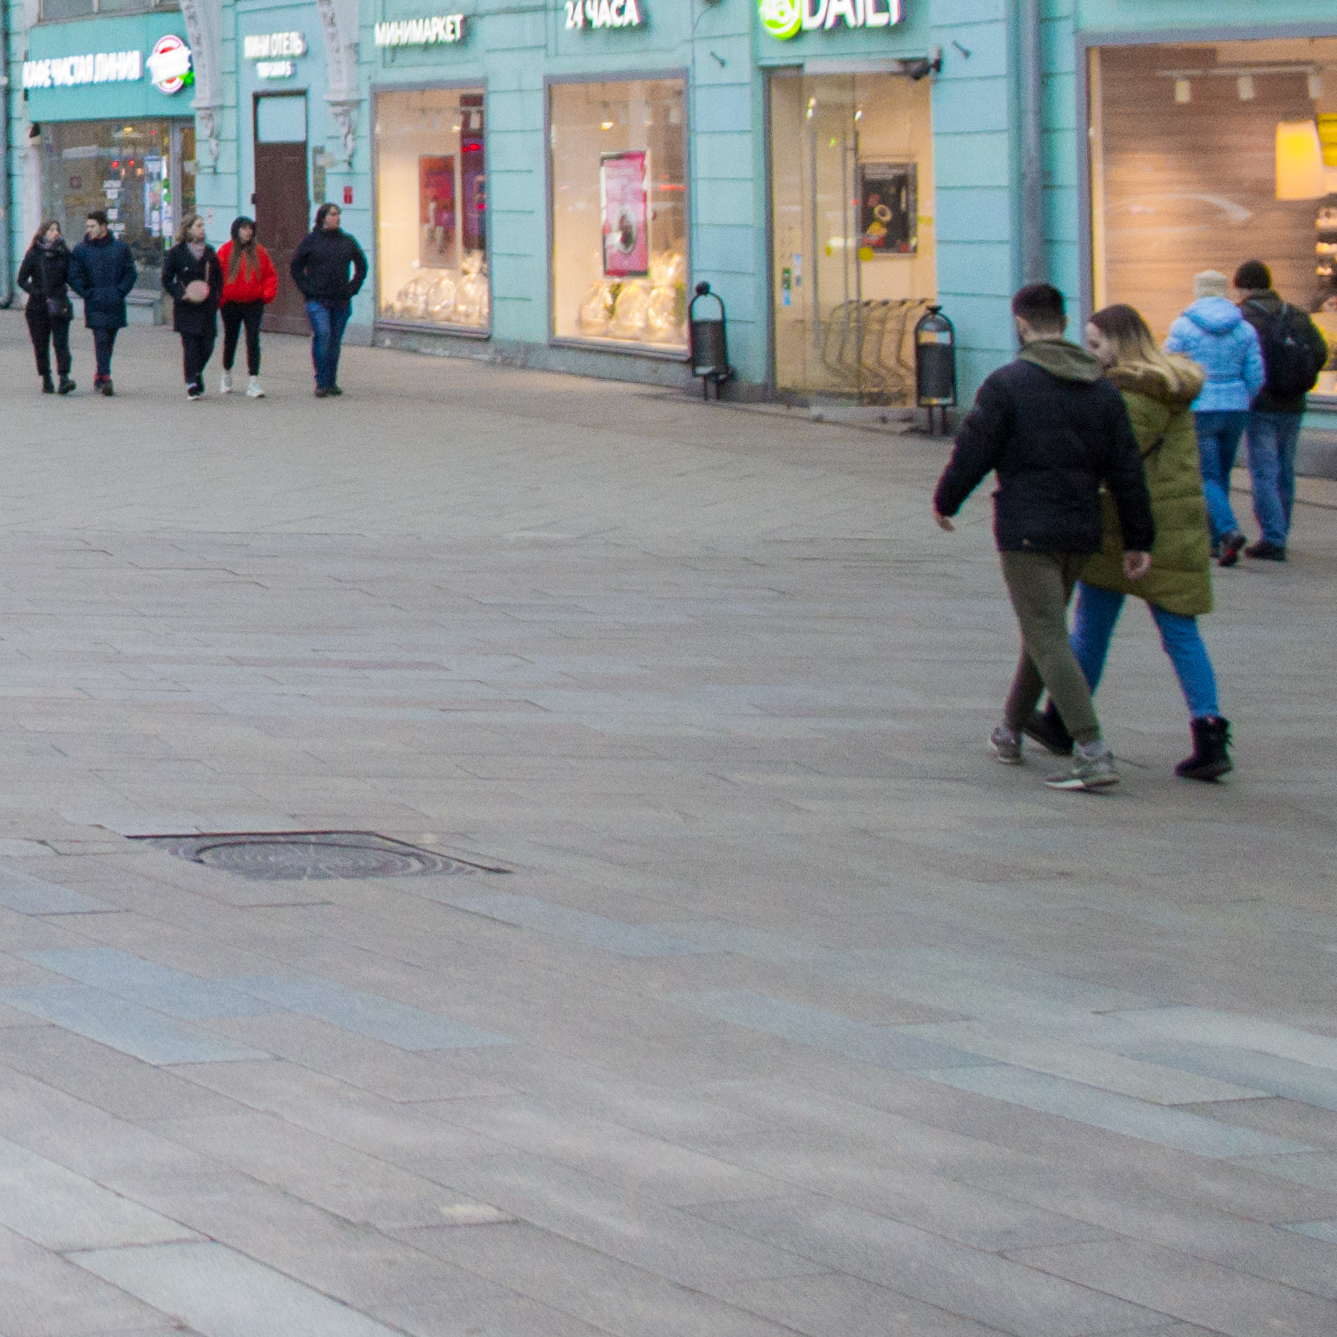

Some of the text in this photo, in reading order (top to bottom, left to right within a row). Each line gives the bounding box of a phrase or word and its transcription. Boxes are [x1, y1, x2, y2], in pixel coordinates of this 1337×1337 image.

[564, 0, 584, 30] 24
[271, 31, 304, 56] ОТЕЛЬ
[374, 14, 465, 47] МИНИМАРКЕТ
